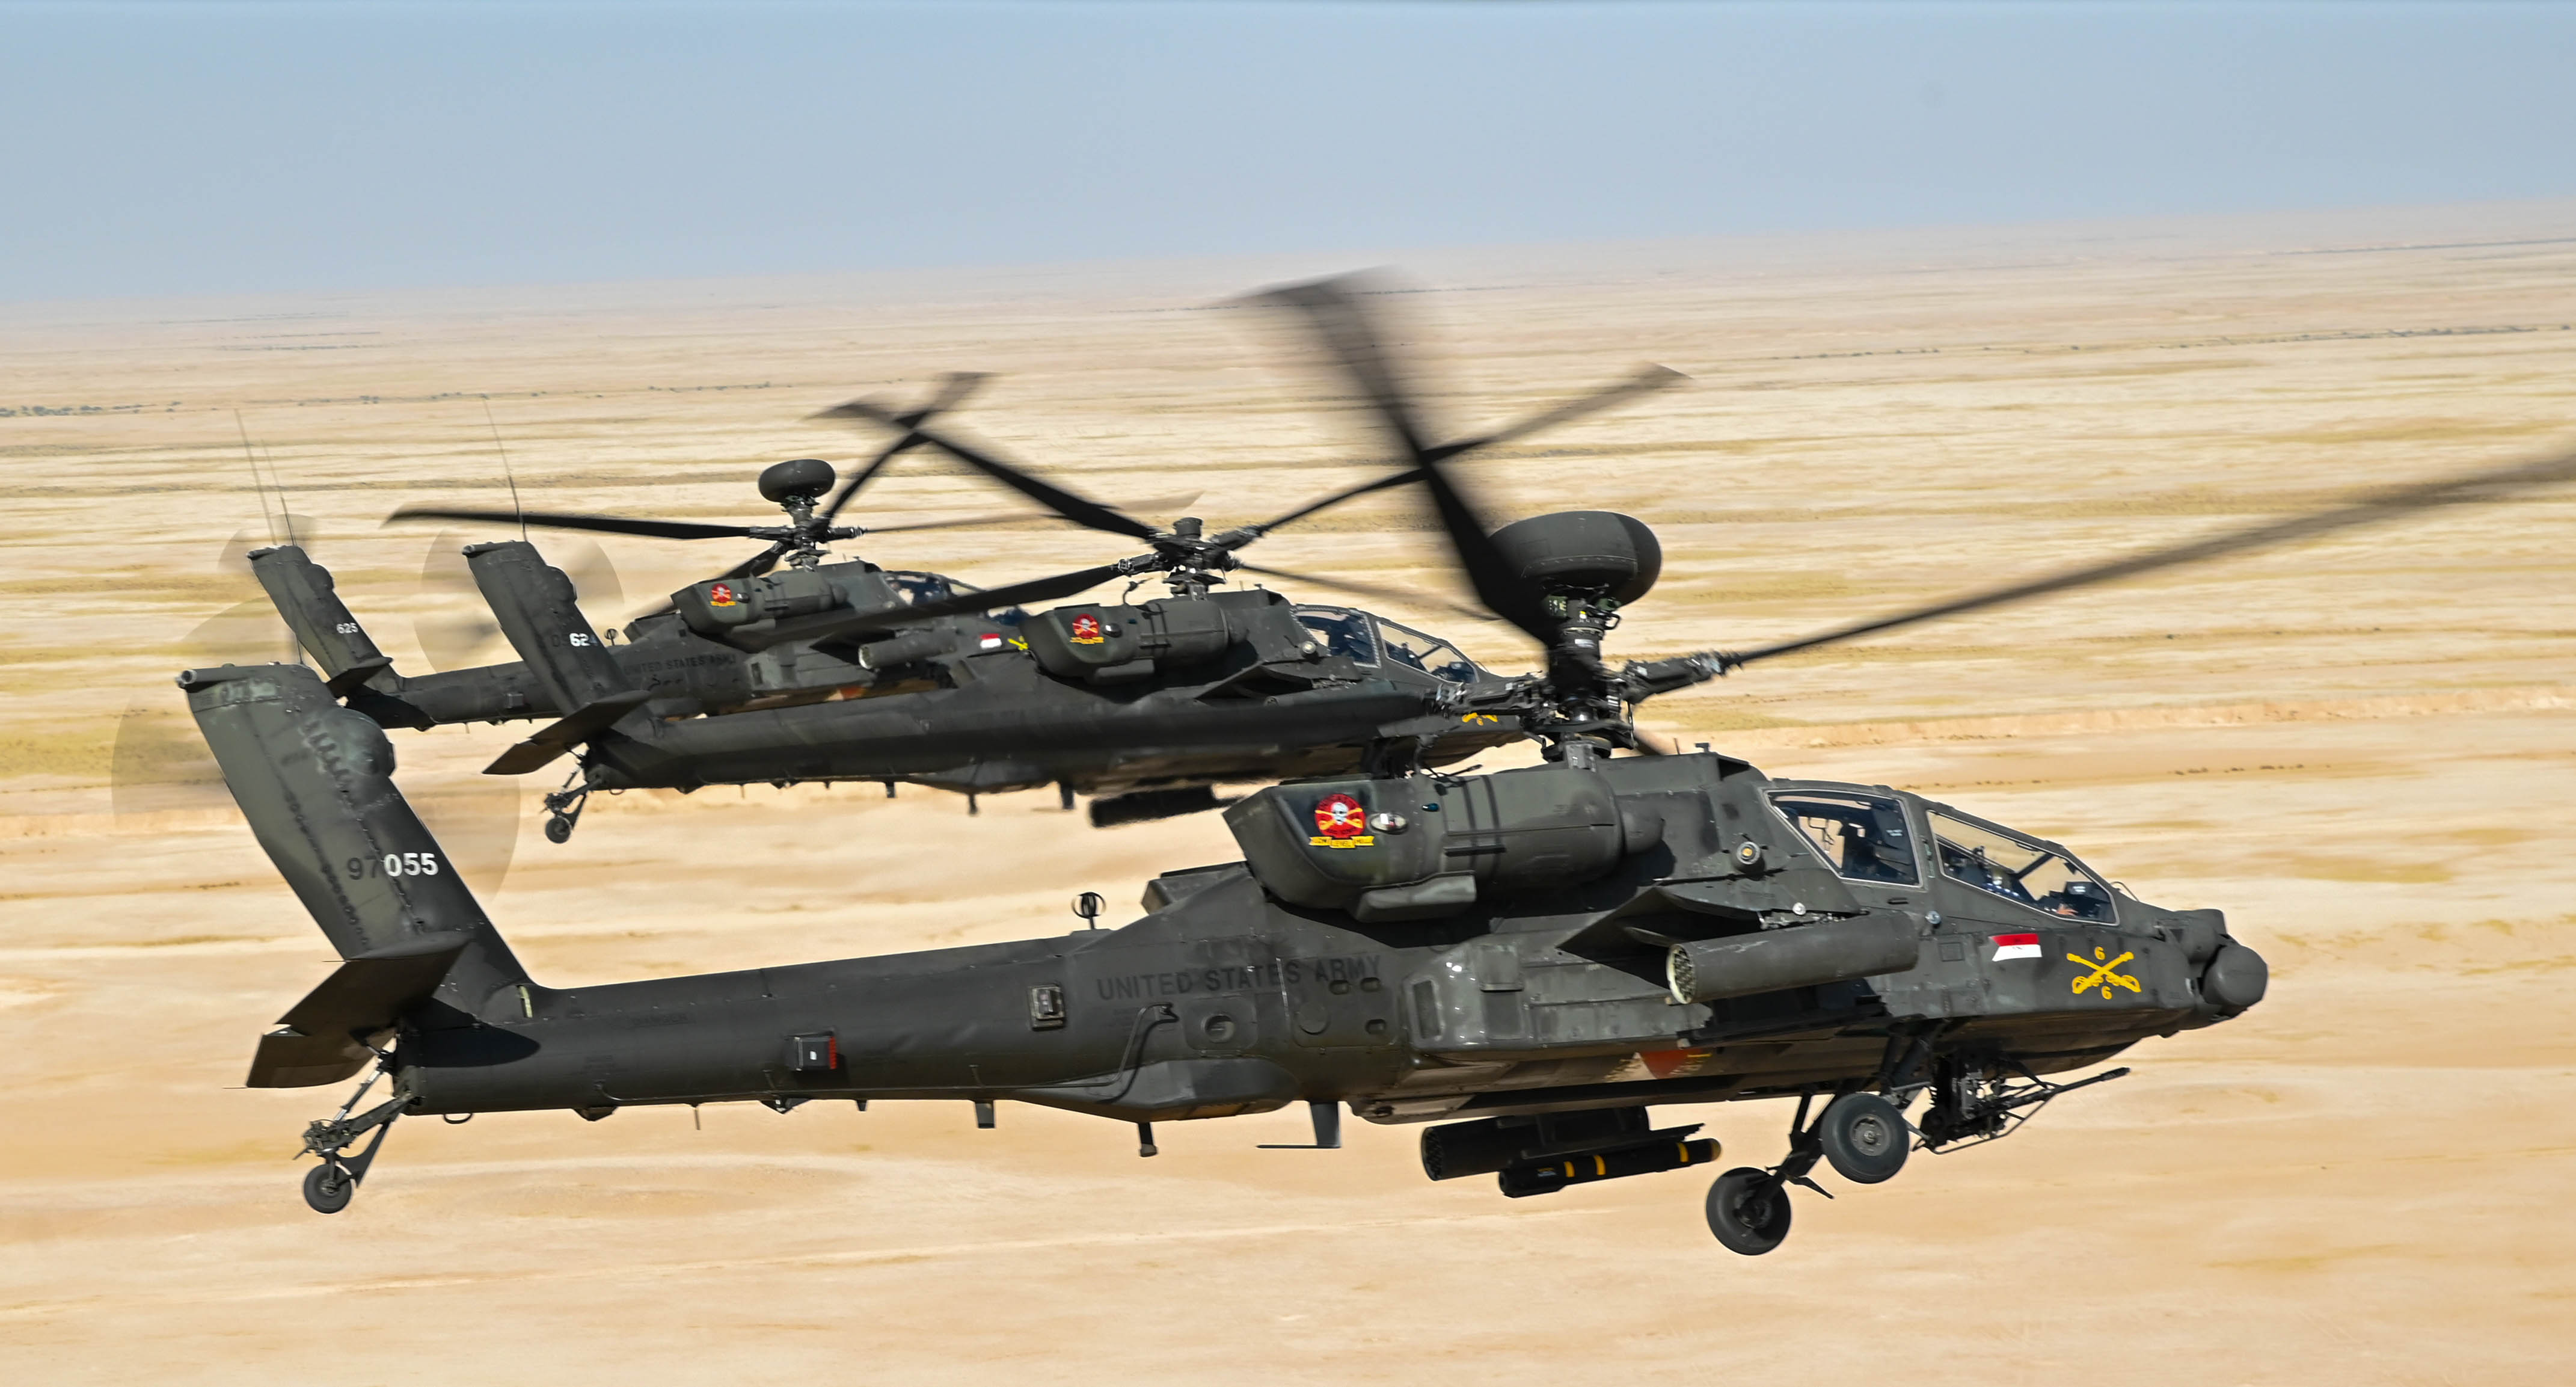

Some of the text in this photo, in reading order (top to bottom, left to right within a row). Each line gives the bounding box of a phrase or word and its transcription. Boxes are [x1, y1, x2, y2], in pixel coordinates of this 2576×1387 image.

[336, 622, 358, 635] 625
[2094, 946, 2106, 961] 6
[1096, 955, 1382, 1001] UNITED STATES ARMY
[2101, 986, 2112, 1000] 6
